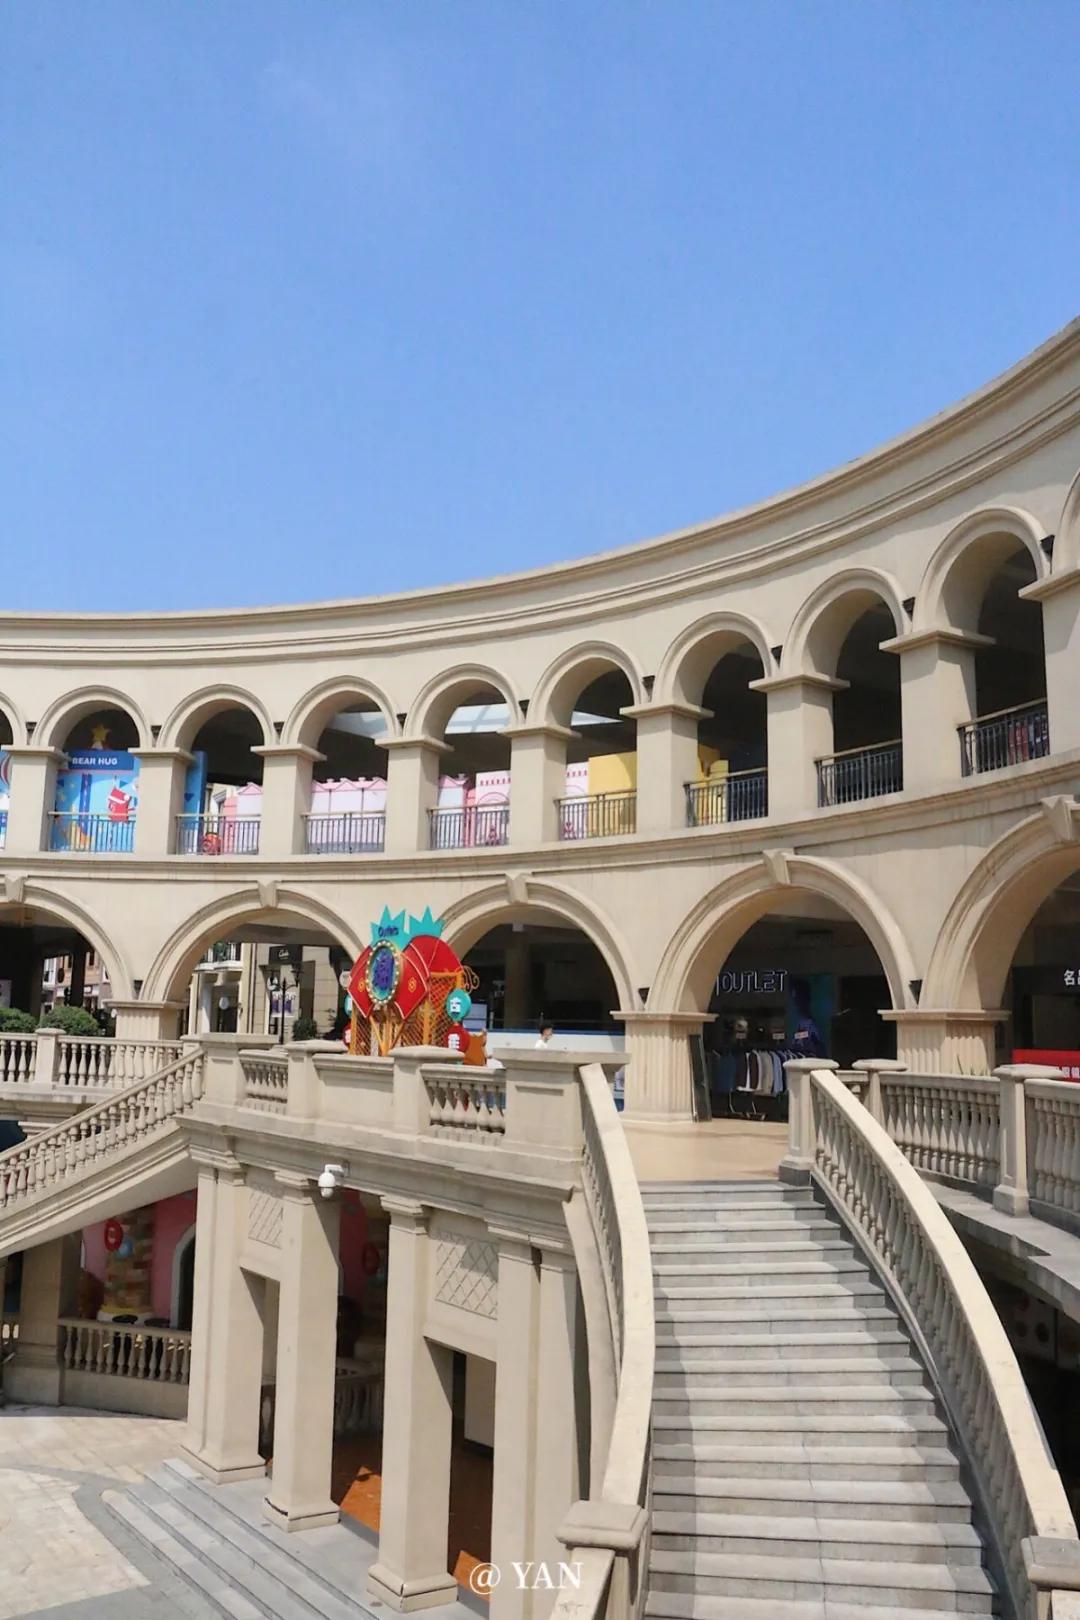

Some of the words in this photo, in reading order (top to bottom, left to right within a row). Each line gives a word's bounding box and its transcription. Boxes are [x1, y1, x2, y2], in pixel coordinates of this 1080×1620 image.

[72, 757, 96, 765] BEAR
[98, 757, 118, 766] HUG
[1063, 969, 1080, 986] 名
